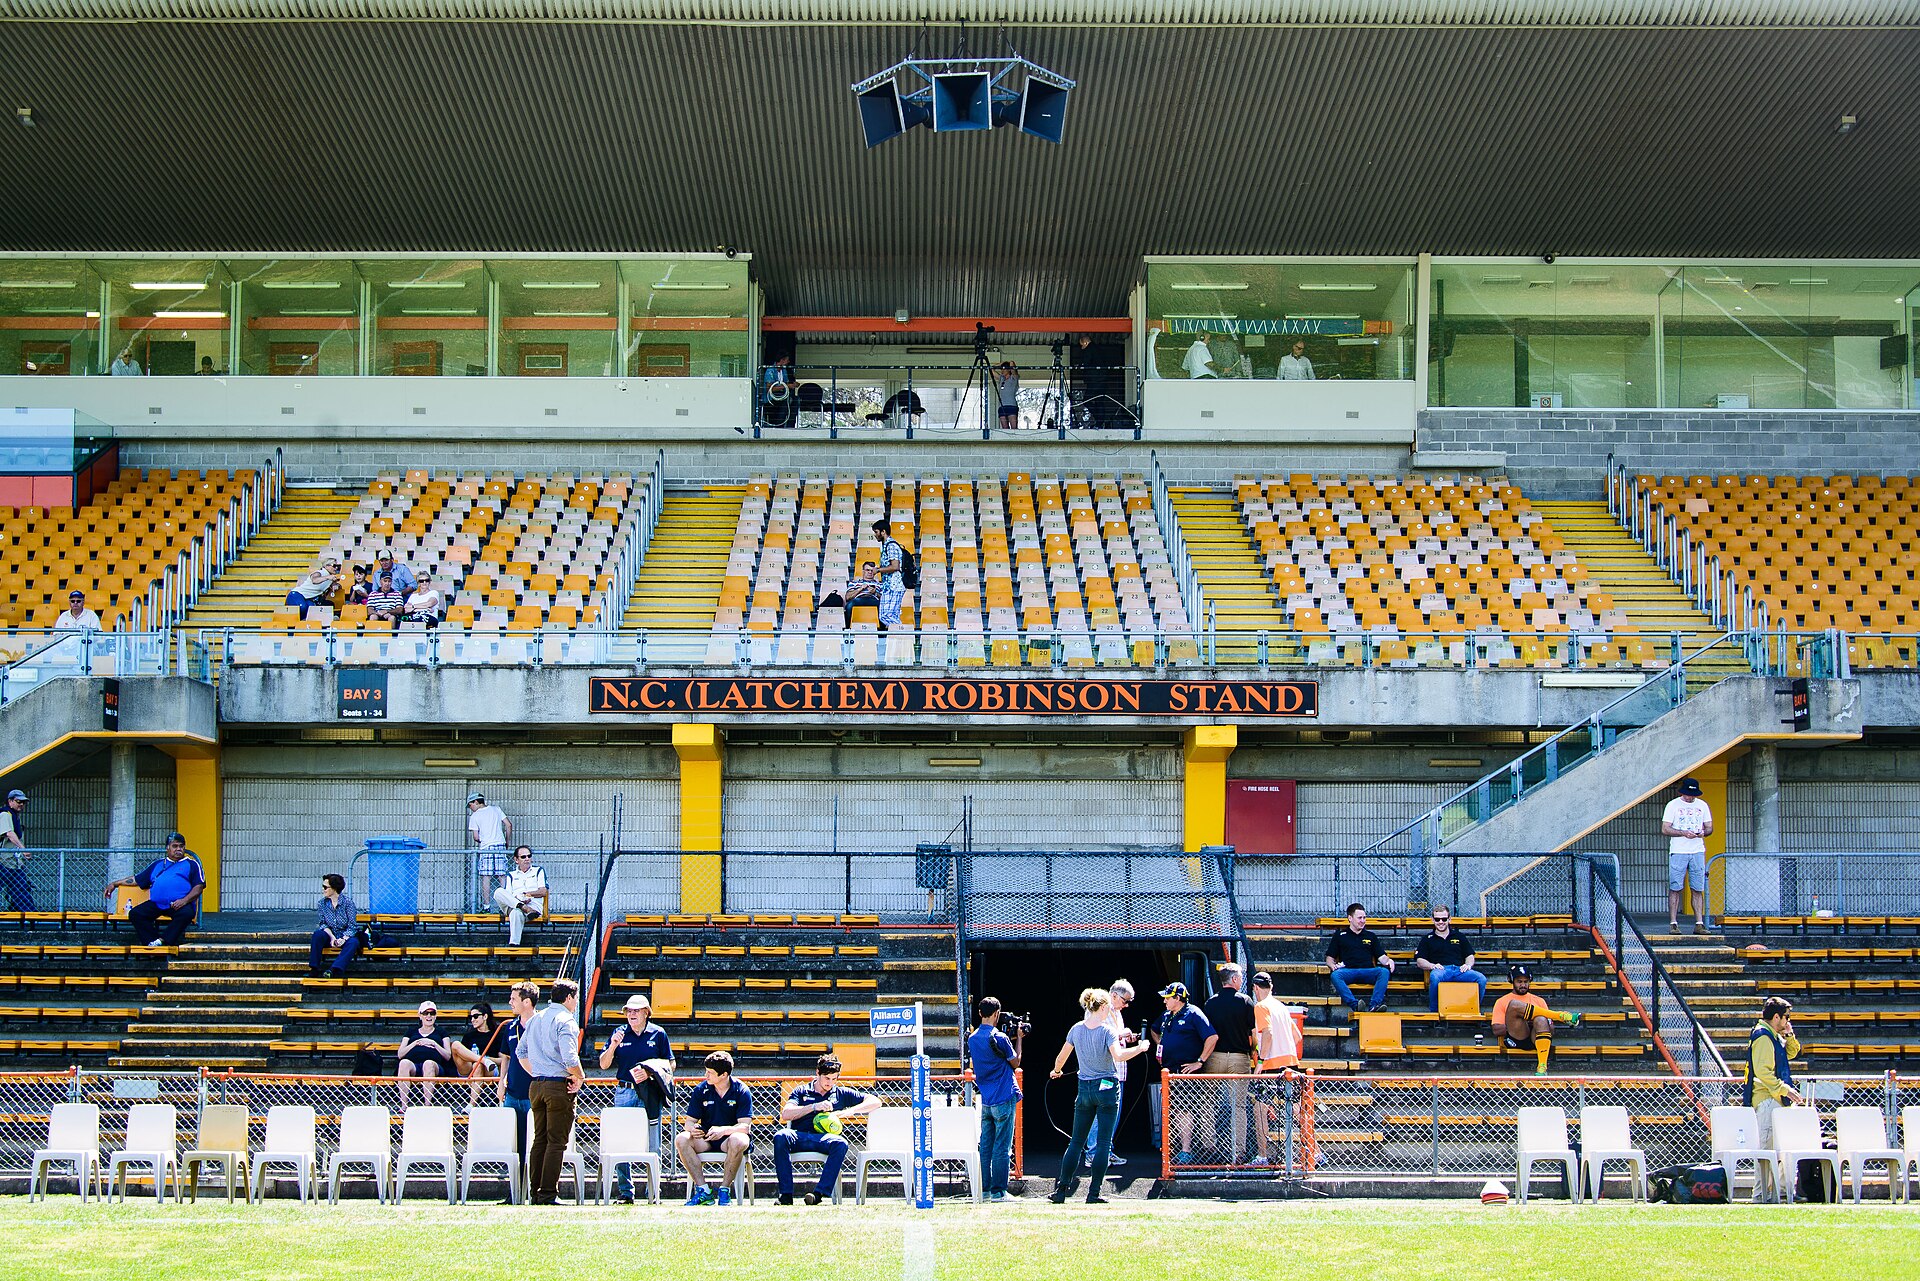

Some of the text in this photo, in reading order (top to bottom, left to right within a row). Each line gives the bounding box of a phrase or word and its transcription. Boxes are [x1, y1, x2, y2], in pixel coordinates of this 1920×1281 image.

[344, 689, 381, 700] BAY 3
[601, 682, 1303, 711] N.C. (LATCHEM) ROBINSON STAND
[874, 1024, 913, 1035] 50M
